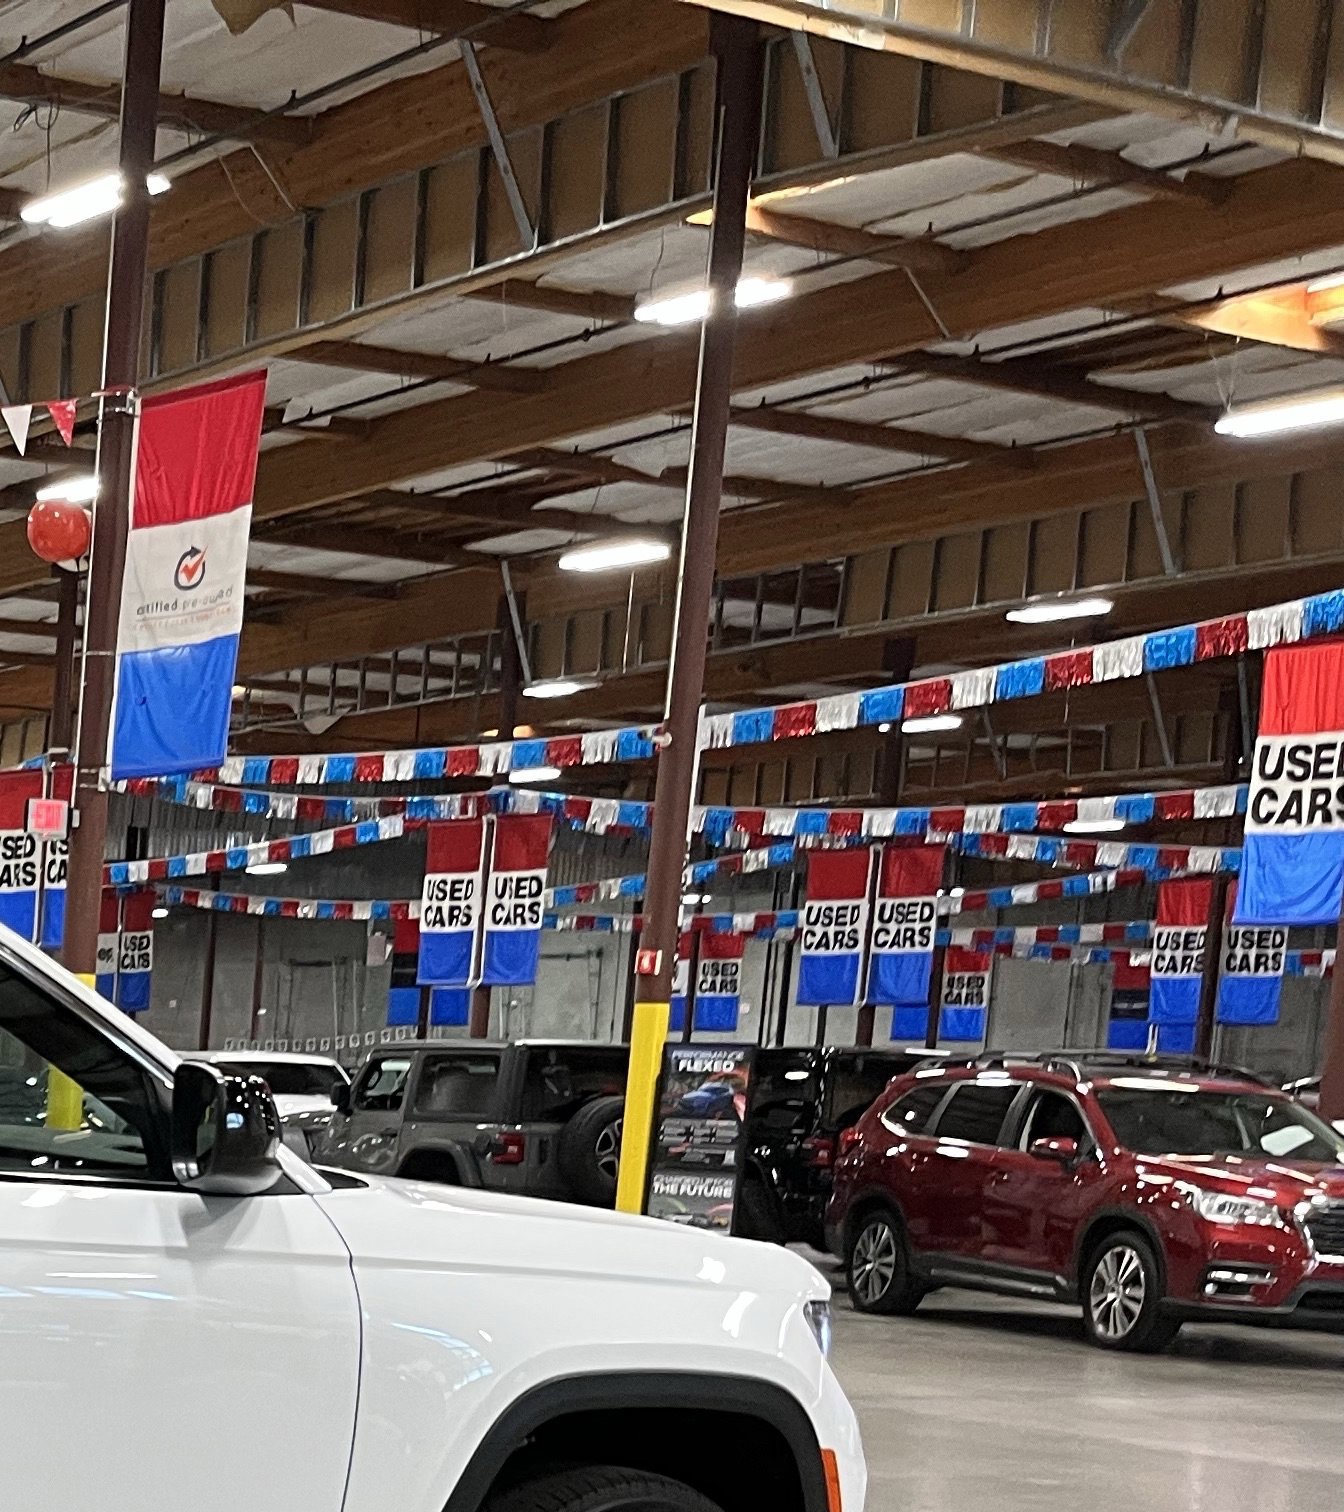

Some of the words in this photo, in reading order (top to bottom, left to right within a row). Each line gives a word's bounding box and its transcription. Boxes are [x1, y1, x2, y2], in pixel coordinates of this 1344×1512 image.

[47, 859, 68, 884] CA
[427, 879, 474, 901] USED
[494, 876, 543, 899] UED
[424, 905, 473, 927] CARS
[492, 902, 540, 925] CARS
[805, 905, 860, 927] USED
[878, 902, 935, 924] USED
[803, 928, 859, 950] CARS
[874, 926, 932, 949] CARS
[1156, 930, 1205, 951] USED
[1227, 930, 1285, 949] USED
[702, 962, 739, 977] USED
[1225, 952, 1283, 972] CARS
[699, 979, 738, 993] CARS
[947, 976, 986, 989] USED
[653, 1181, 679, 1195] THE
[680, 1182, 733, 1198] FUTURE
